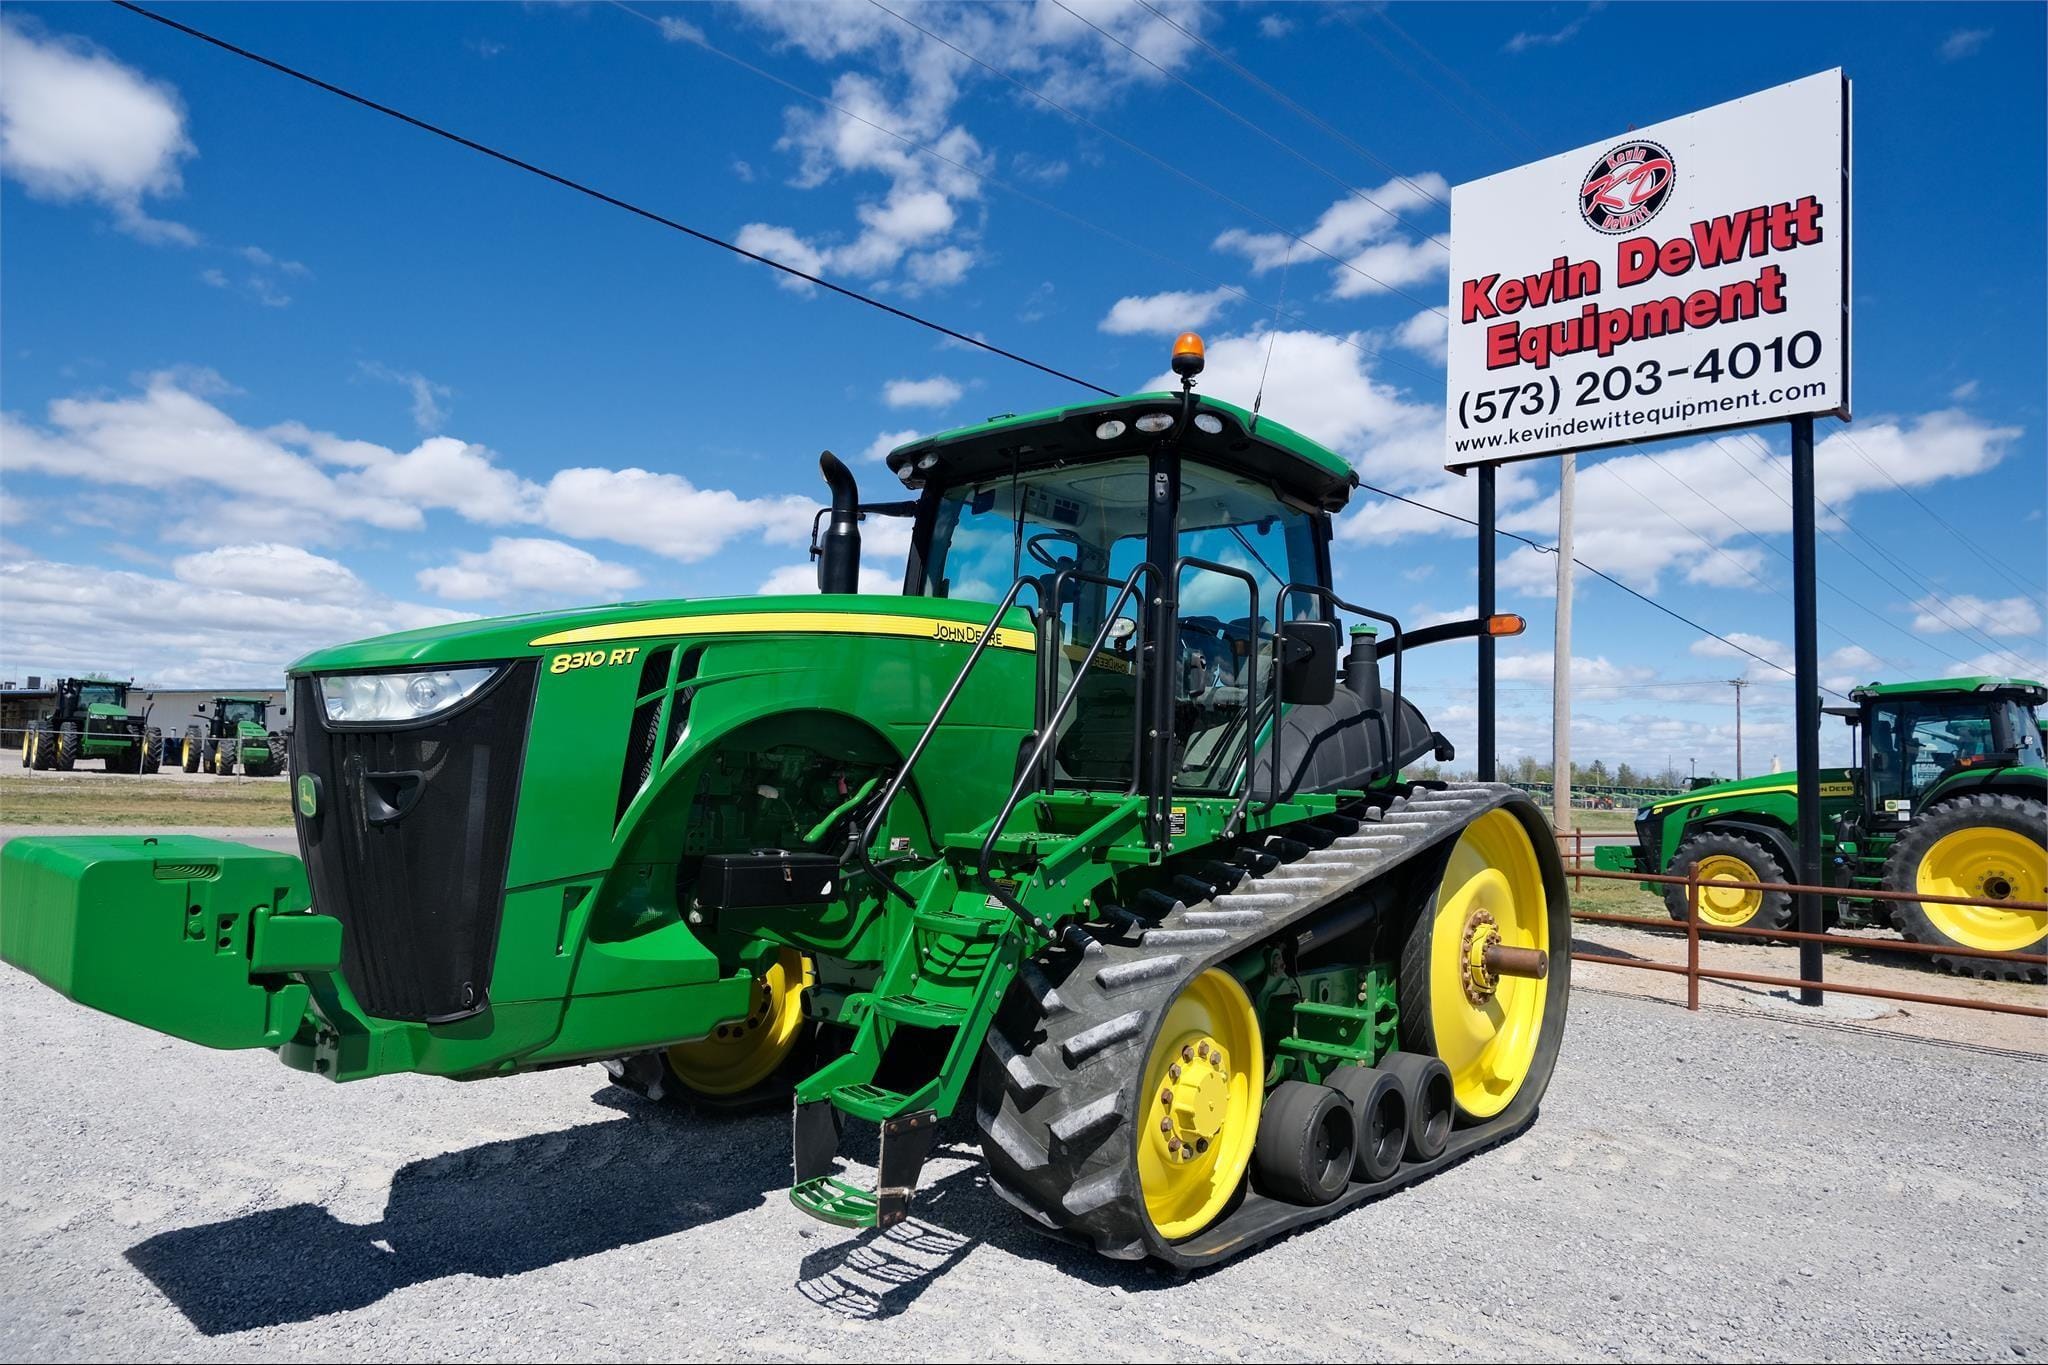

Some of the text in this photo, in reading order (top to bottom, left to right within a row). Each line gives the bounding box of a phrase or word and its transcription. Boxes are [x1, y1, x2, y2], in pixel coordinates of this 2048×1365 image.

[1606, 146, 1647, 169] Kevin
[1582, 158, 1673, 217] KD
[1602, 204, 1651, 230] DeWitt
[1462, 195, 1823, 324] Kevin DeWitt
[1487, 264, 1787, 370] Equipment
[1458, 330, 1822, 429] (573) 203-4010
[1455, 381, 1826, 452] www.kevindewittequipment.com
[550, 647, 641, 675] 8310 RT
[933, 623, 1003, 645] JOHN DERE
